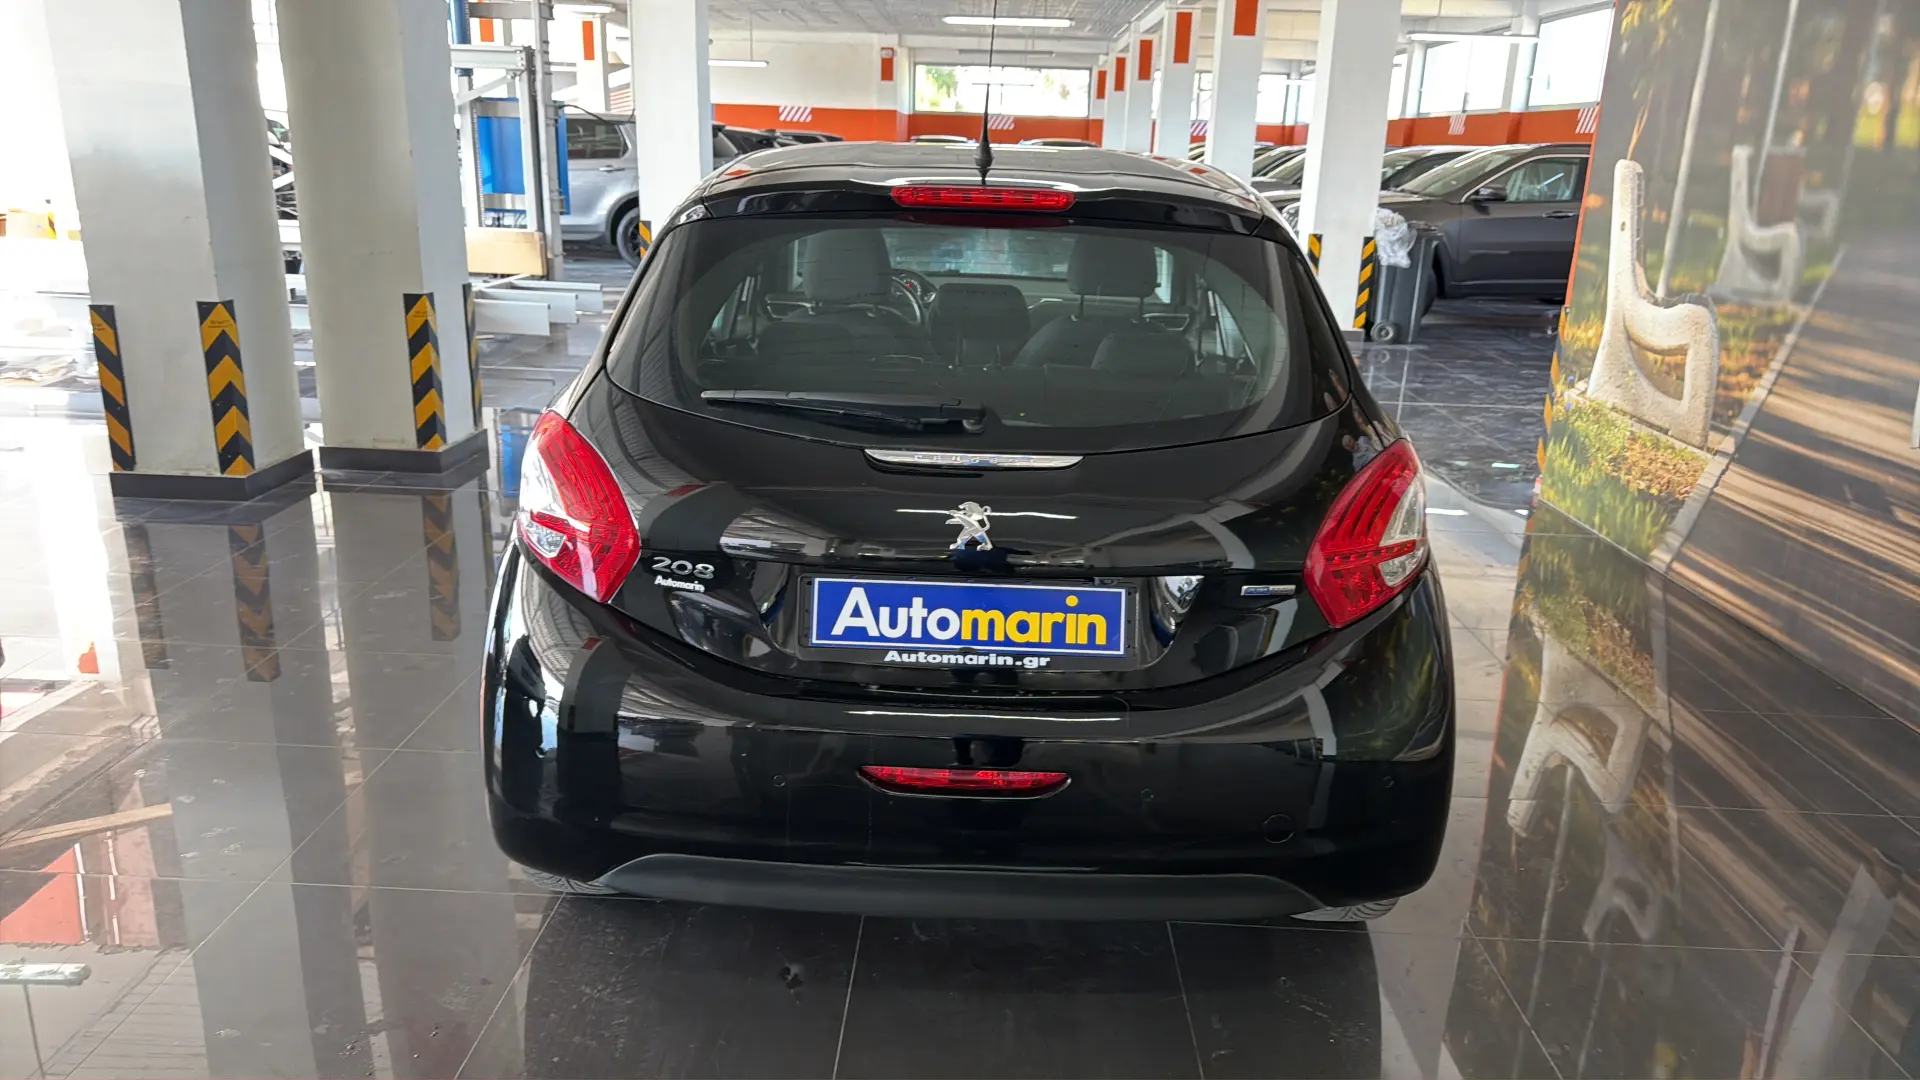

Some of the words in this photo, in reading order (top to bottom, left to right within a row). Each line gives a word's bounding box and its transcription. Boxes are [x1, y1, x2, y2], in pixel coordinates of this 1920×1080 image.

[651, 556, 715, 579] 208
[654, 575, 705, 593] Automarin
[831, 587, 1107, 645] Automarin
[884, 650, 1051, 669] Automarin.gr
